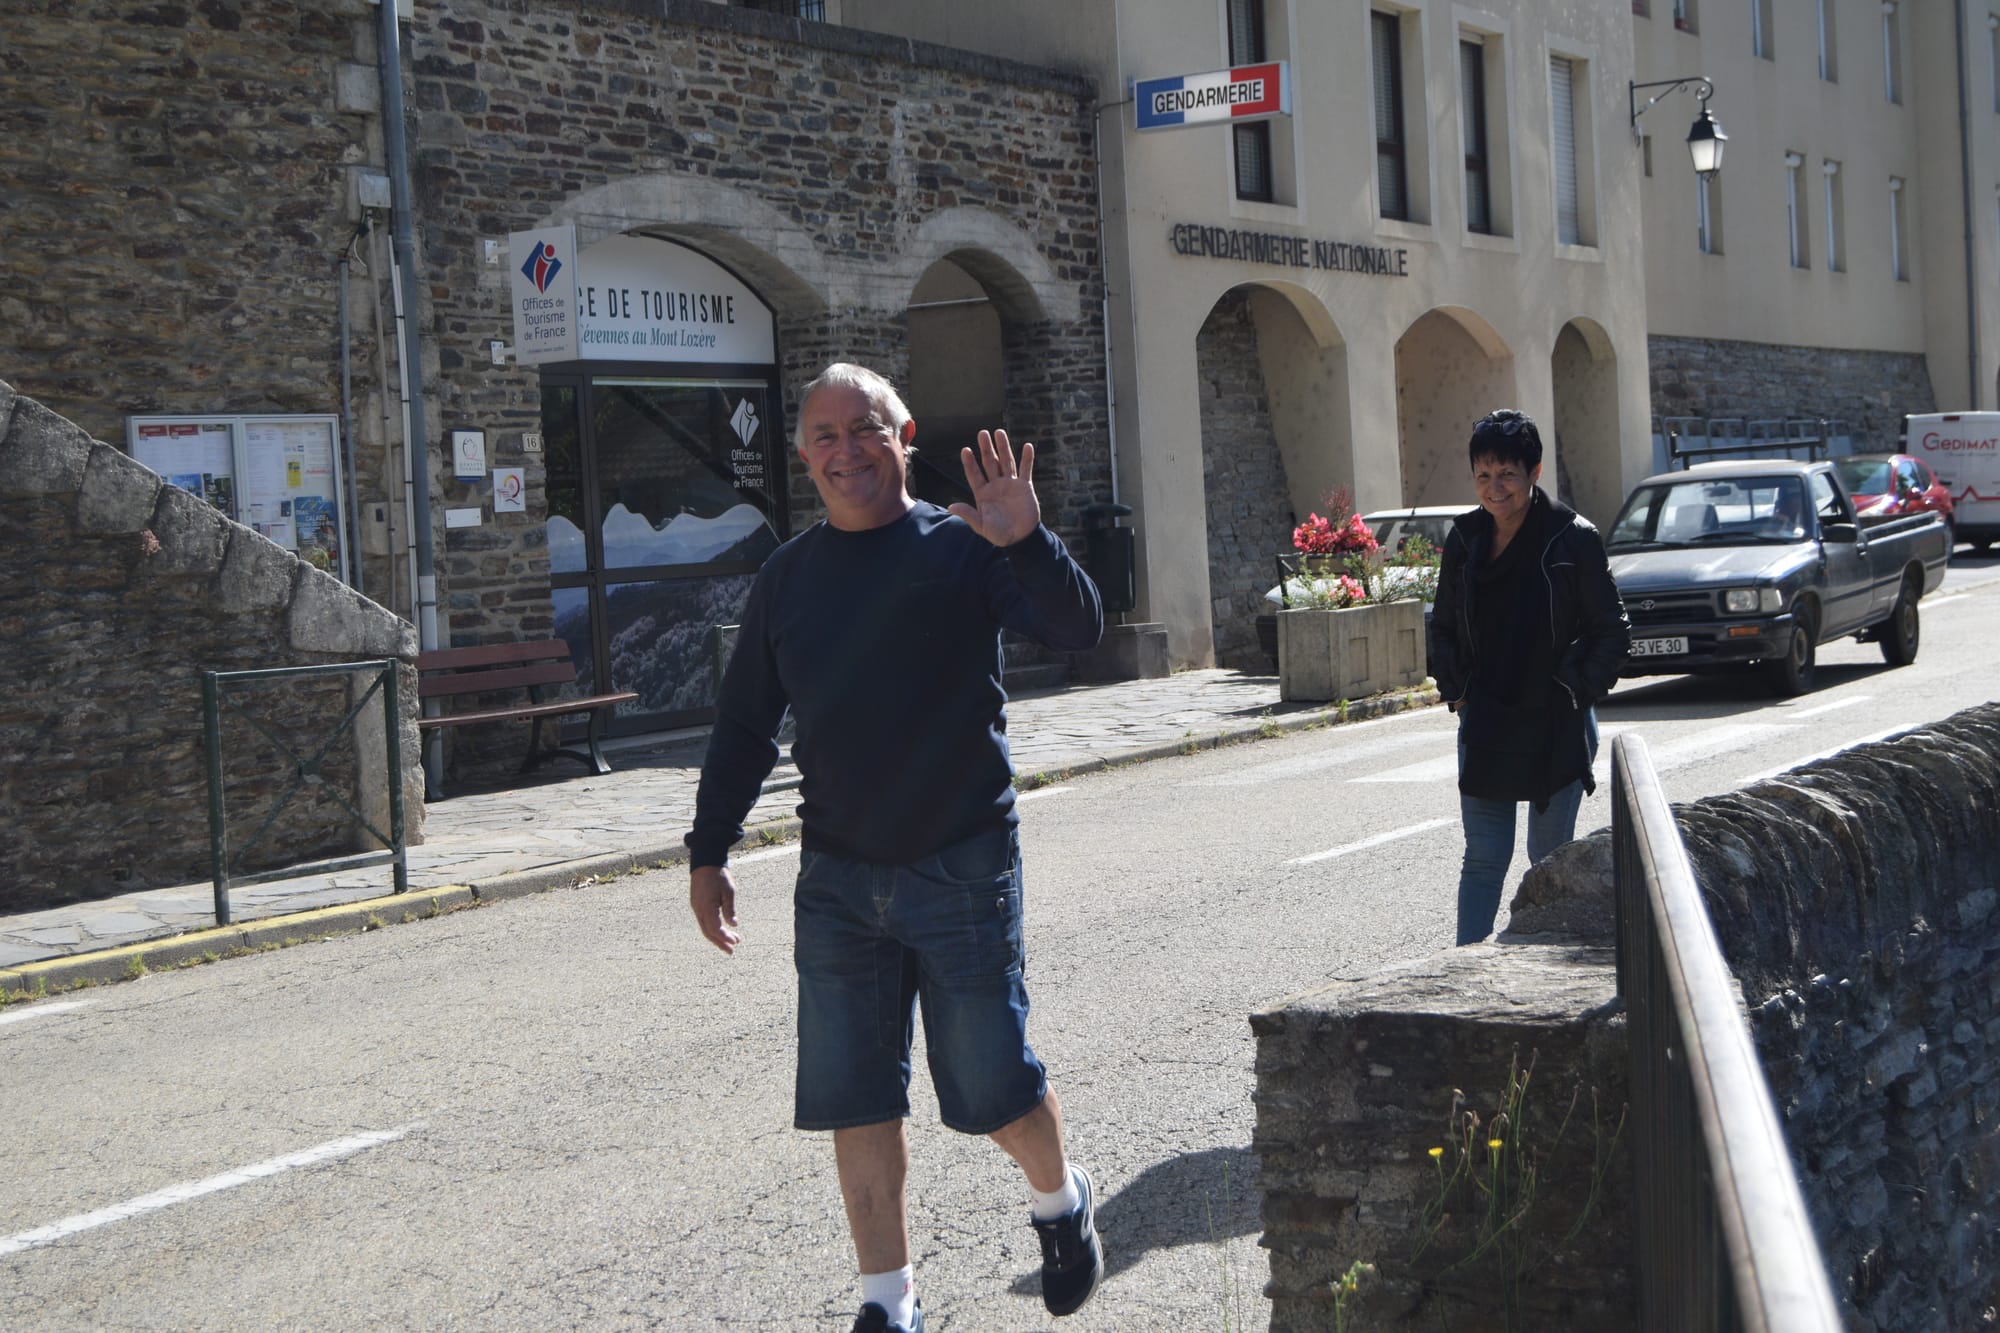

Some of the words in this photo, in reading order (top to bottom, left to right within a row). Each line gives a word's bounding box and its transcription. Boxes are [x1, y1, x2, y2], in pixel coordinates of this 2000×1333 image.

[1154, 81, 1262, 114] GENDARMERIE
[1171, 223, 1310, 267] GENDARMERIE
[1313, 240, 1408, 277] NATIONALE
[522, 297, 554, 311] Offices
[555, 298, 565, 307] de
[608, 288, 631, 318] DE
[641, 290, 735, 324] TOURISME
[523, 312, 565, 325] Tourisme
[524, 332, 533, 341] de
[534, 326, 566, 340] France
[581, 323, 629, 344] évennes
[632, 331, 647, 345] au
[650, 327, 677, 346] Mont
[680, 329, 716, 348] Lozère
[526, 437, 537, 448] 16
[731, 449, 755, 461] Offices
[733, 462, 763, 474] Tourisme
[741, 476, 764, 487] France
[1648, 640, 1664, 654] VE
[1665, 639, 1682, 653] 30
